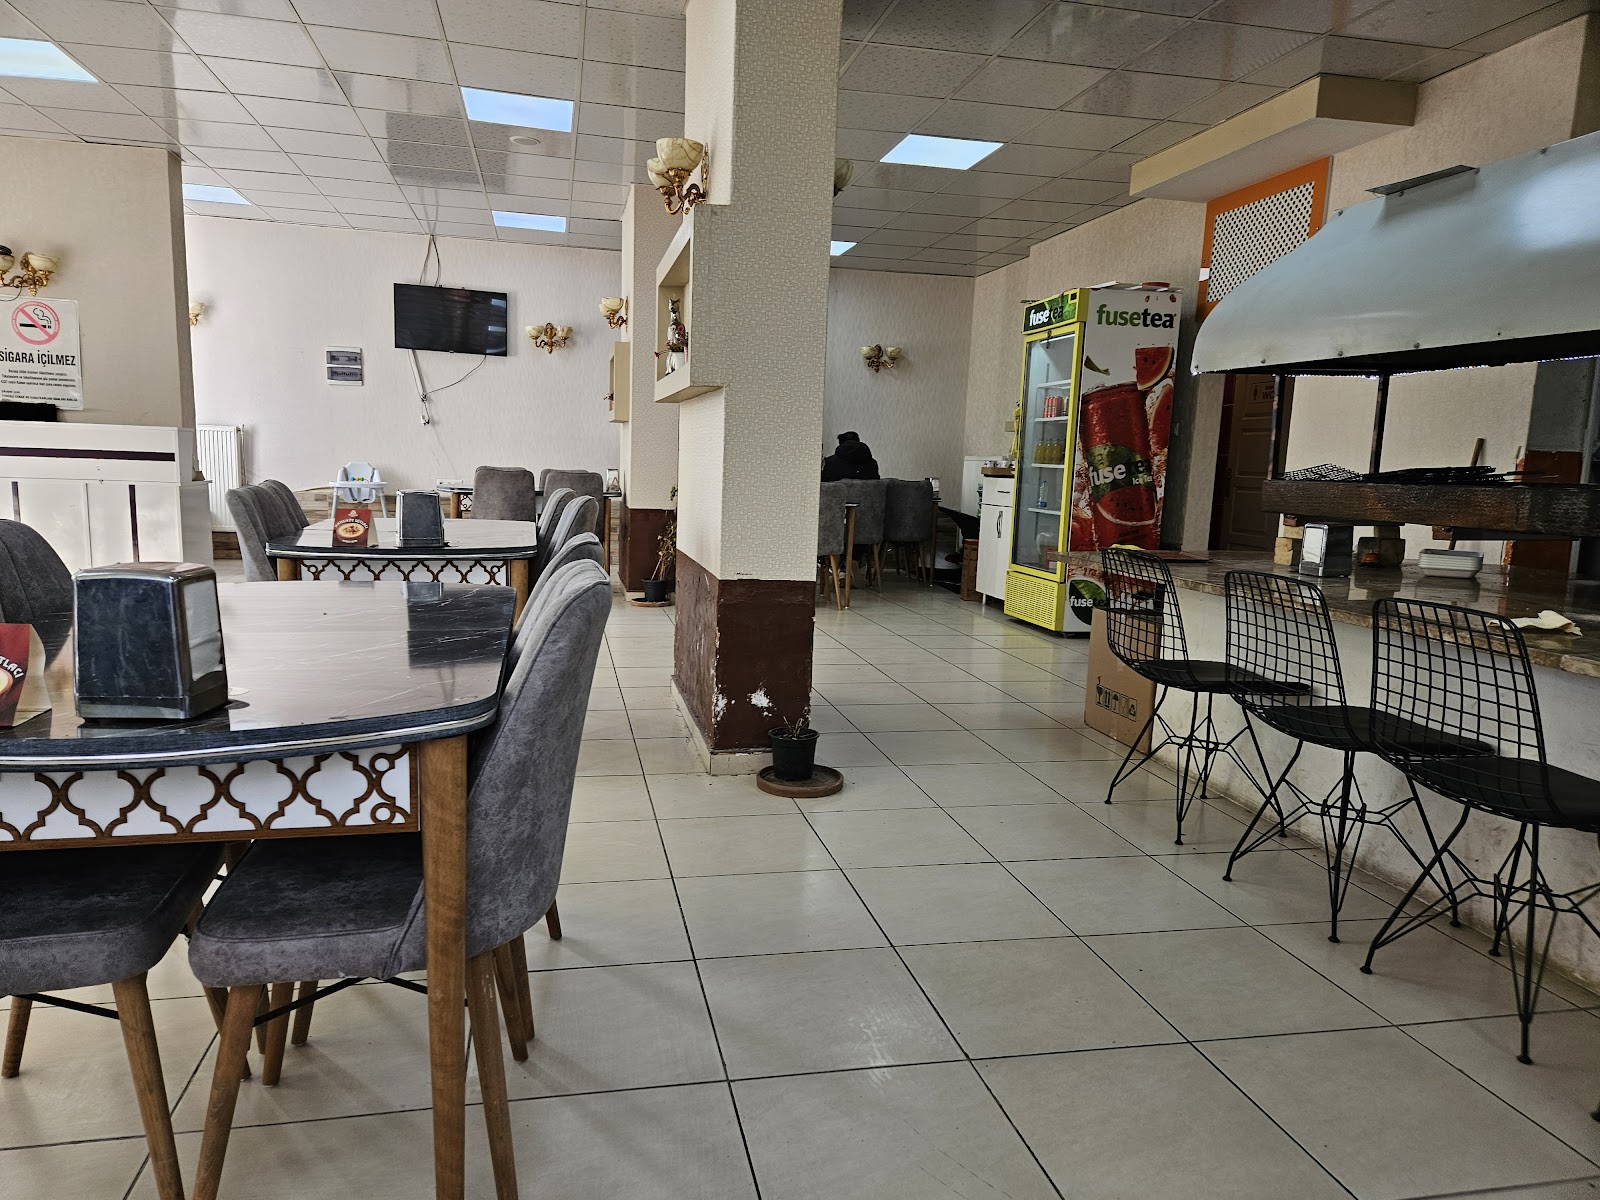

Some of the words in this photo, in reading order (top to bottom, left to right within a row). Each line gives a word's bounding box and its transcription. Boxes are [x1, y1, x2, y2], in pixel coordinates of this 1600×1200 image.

[1029, 305, 1064, 327] fusetea
[1097, 304, 1174, 328] fusetea
[0, 347, 35, 364] SİGARA
[37, 349, 76, 367] İÇİLMEZ
